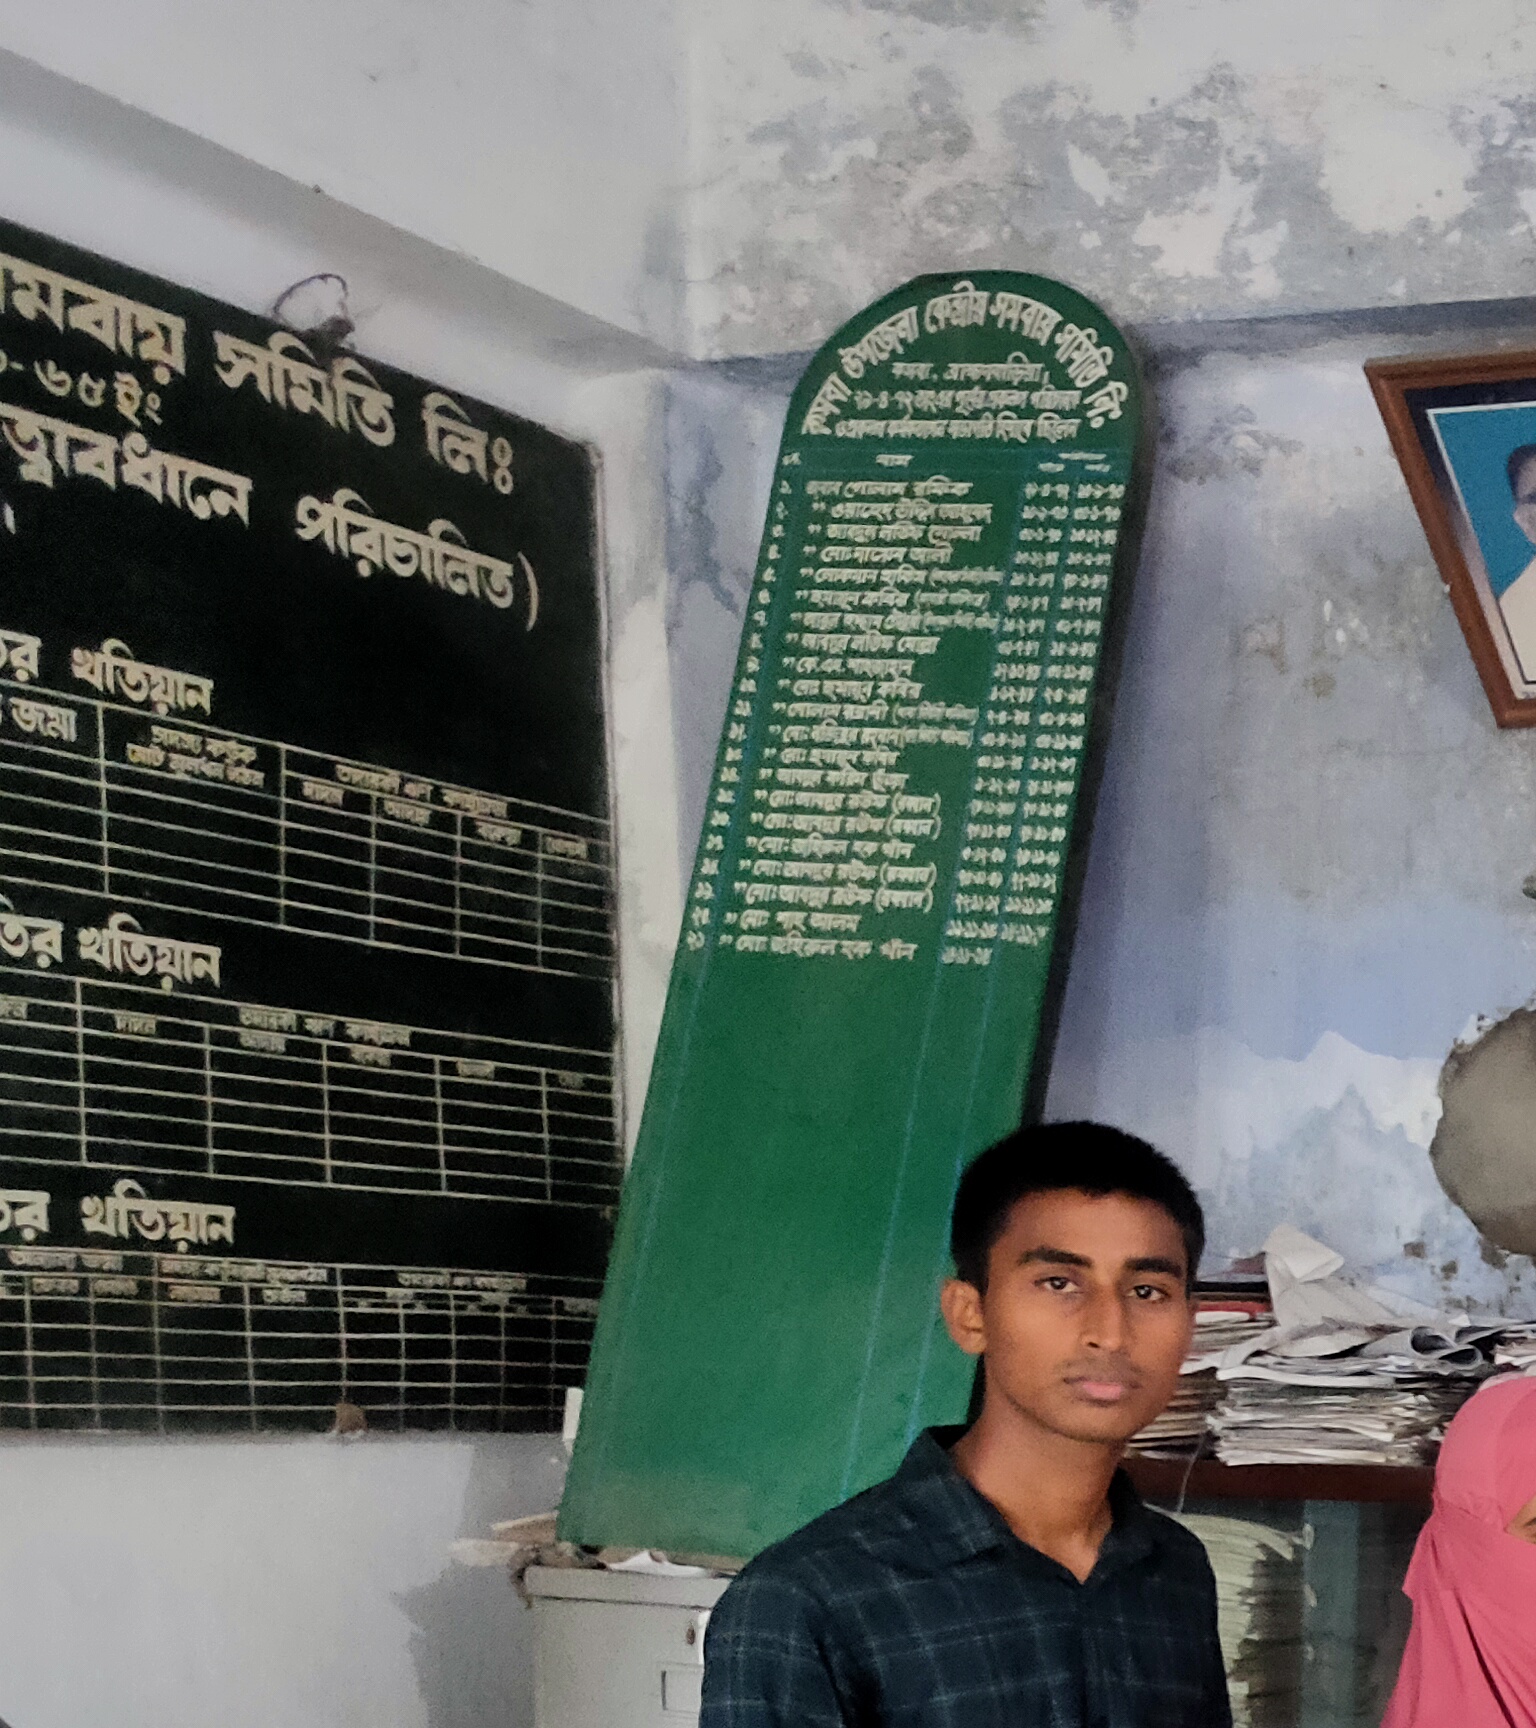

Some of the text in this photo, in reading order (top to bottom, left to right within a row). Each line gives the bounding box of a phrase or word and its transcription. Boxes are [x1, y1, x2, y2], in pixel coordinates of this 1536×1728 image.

[838, 306, 919, 378] উপজেলা
[990, 292, 1064, 346] সমবায়
[0, 253, 513, 497] মবায় সমিতি লিঃ
[1055, 323, 1114, 388] সমিতি
[801, 372, 852, 435] কসবা
[1083, 381, 1128, 428] লিঃ
[295, 488, 539, 632] পরিচালিত)
[71, 638, 214, 716] খতিয়ান
[9, 697, 77, 743] জমা
[79, 912, 222, 995] খতিয়ান
[81, 1179, 235, 1254] খতিয়ান
